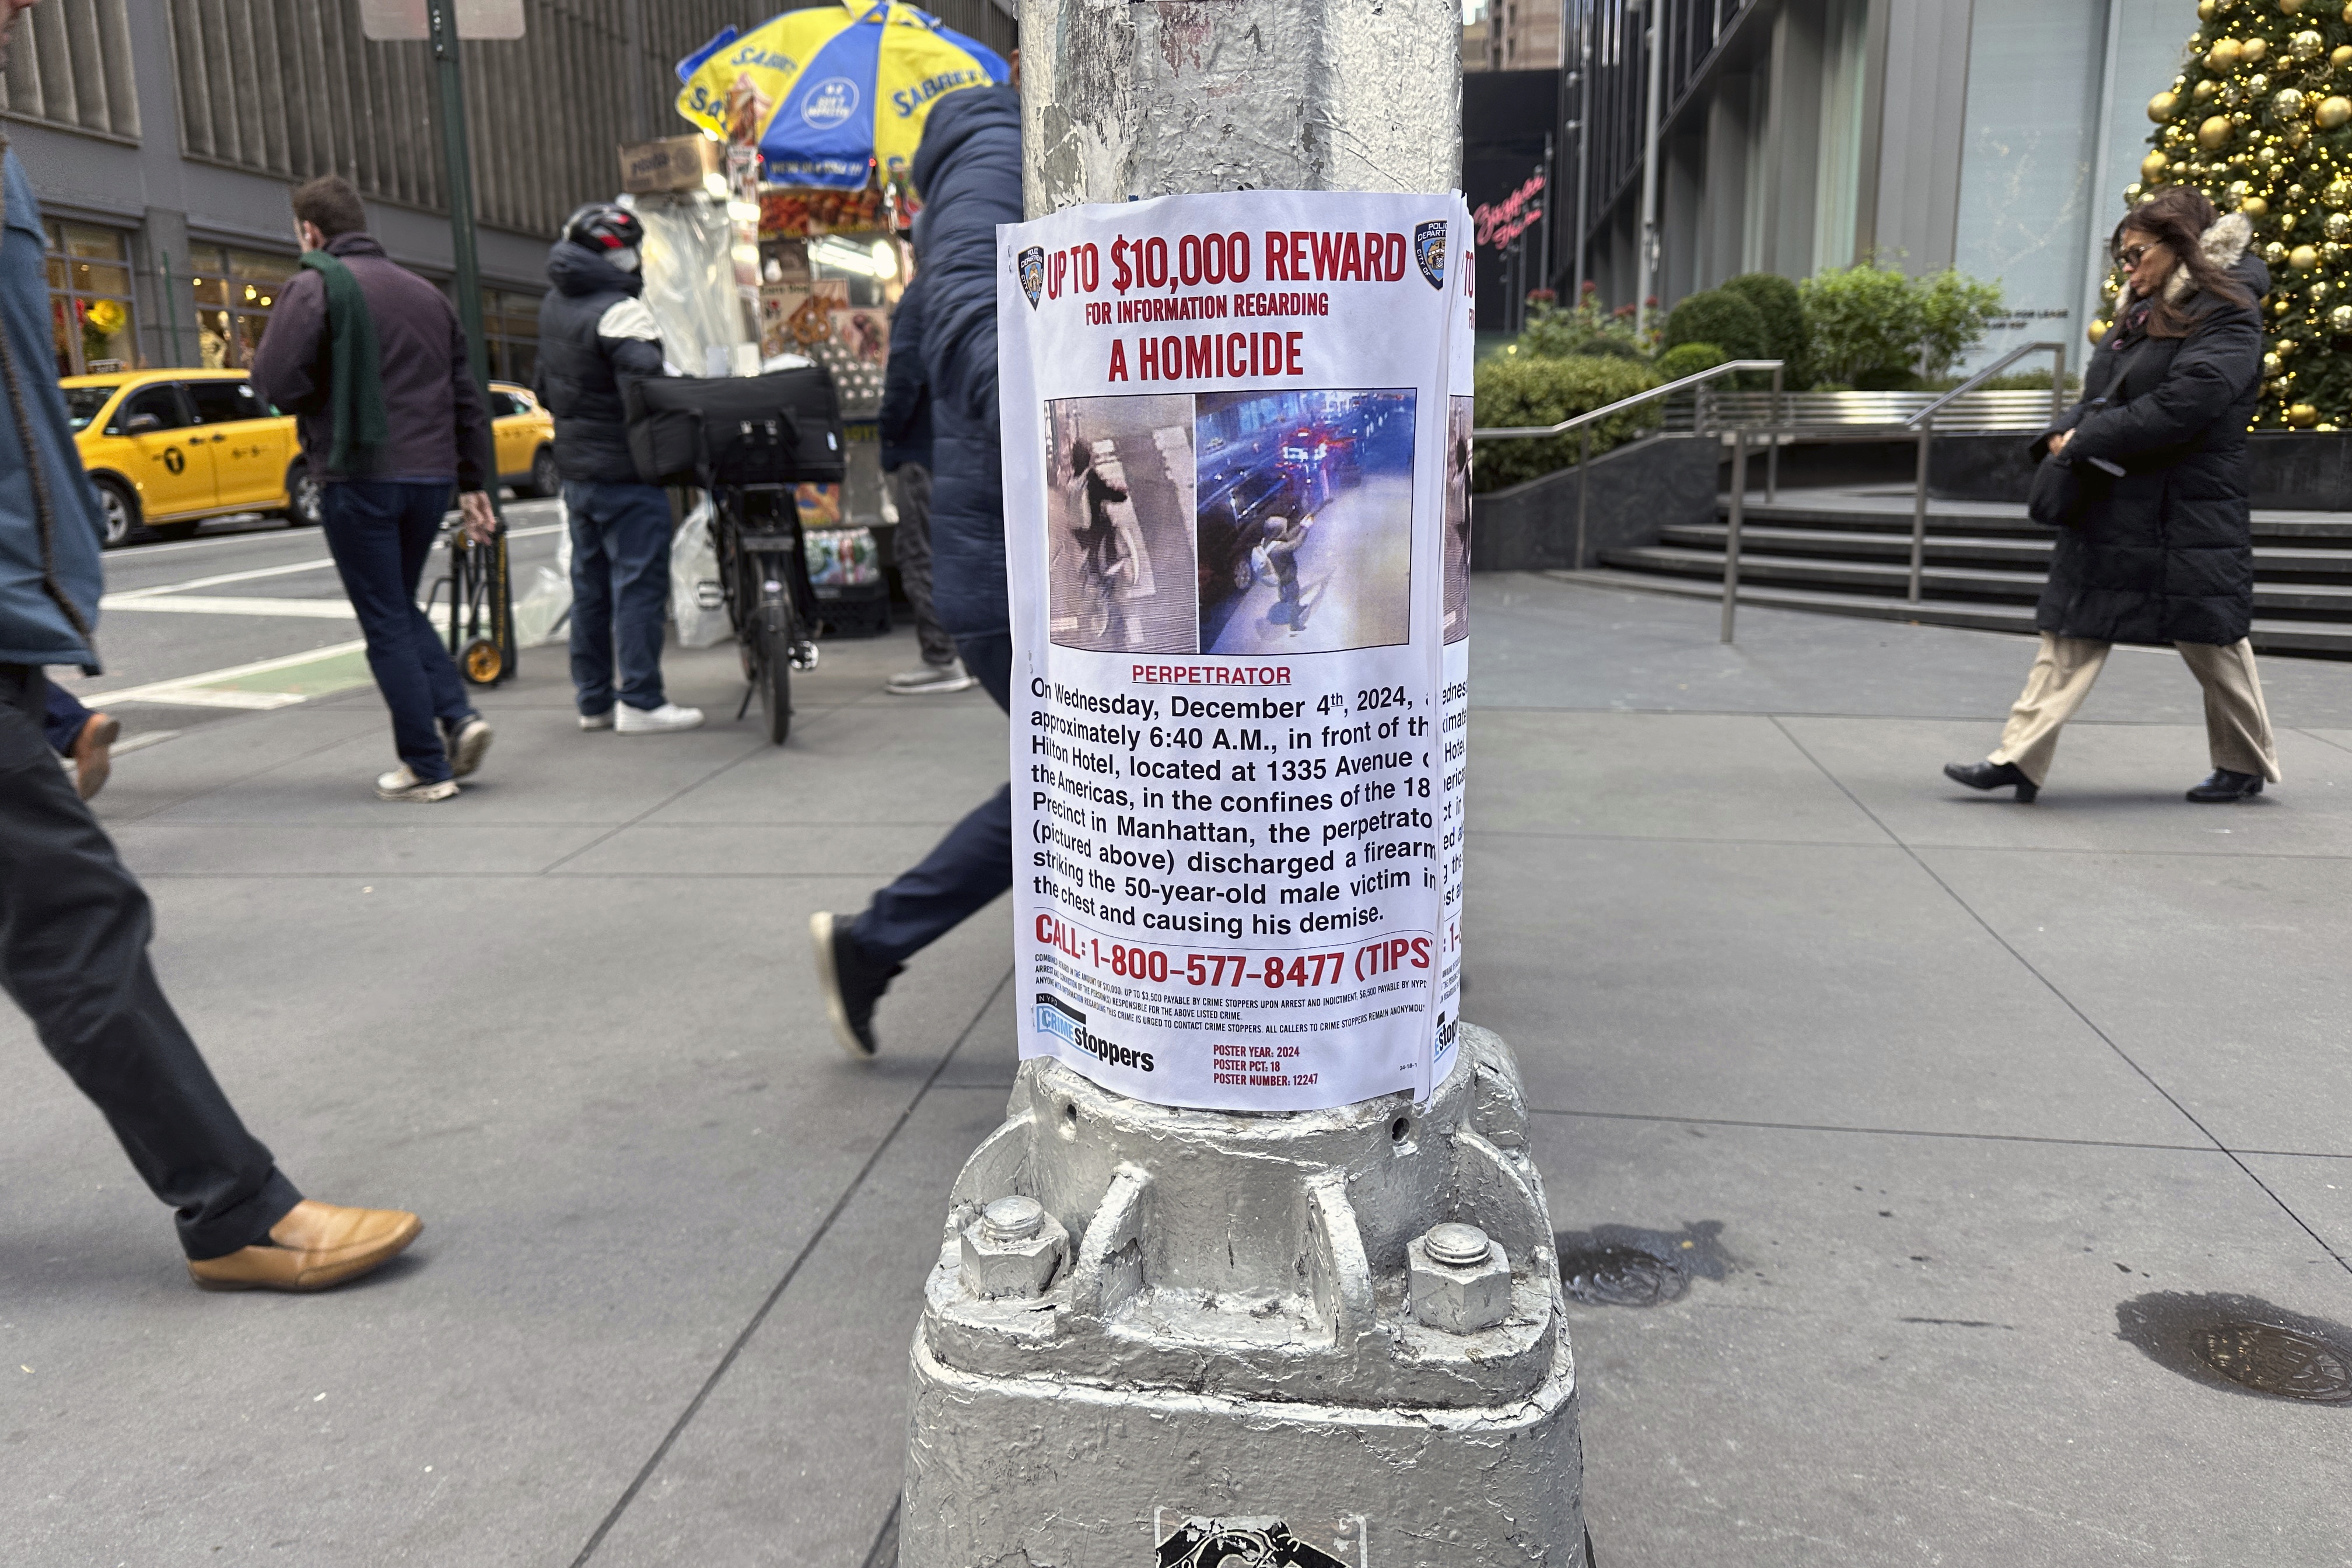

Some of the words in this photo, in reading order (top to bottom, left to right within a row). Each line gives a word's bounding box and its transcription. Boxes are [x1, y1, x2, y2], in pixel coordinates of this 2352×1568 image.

[1048, 250, 1066, 300] UP
[1070, 243, 1099, 293] TO
[1111, 232, 1250, 295] $10,000
[1265, 231, 1407, 282] REWARD
[1416, 249, 1425, 265] CITY
[1423, 267, 1431, 276] OF
[1086, 301, 1112, 326] FOR
[1117, 295, 1227, 324] INFORMATION
[1234, 292, 1328, 317] REGARDING
[1108, 339, 1129, 382] A
[1139, 331, 1304, 381] HOMICIDE
[1132, 664, 1291, 684] PERPETRATOR
[1031, 677, 1051, 700] On
[1055, 682, 1159, 721] Wednesday,
[1171, 695, 1306, 719] December
[1317, 692, 1348, 718] 4th,
[1357, 685, 1413, 711] 2024,
[1031, 710, 1140, 751] approximately
[1150, 726, 1203, 749] 6:40
[1212, 728, 1277, 754] A.M.,
[1289, 728, 1311, 750] in
[1321, 721, 1371, 747] front
[1378, 716, 1399, 738] of
[1032, 735, 1068, 764] Hilton
[1072, 747, 1120, 779] Hotel,
[1130, 755, 1220, 780] located
[1231, 762, 1256, 782] at
[1267, 758, 1326, 781] 1335
[1335, 751, 1413, 777] Avenue
[1031, 764, 1055, 786] the
[1058, 771, 1135, 811] Americas,
[1143, 787, 1164, 808] in
[1171, 789, 1212, 811] the
[1220, 790, 1333, 813] confines
[1340, 783, 1360, 807] of
[1365, 780, 1395, 803] the
[1032, 792, 1086, 827] Precinct
[1091, 810, 1107, 833] in
[1117, 815, 1255, 848] Manhattan,
[1268, 822, 1310, 844] the
[1032, 819, 1091, 858] (pictured
[1099, 844, 1174, 875] above)
[1187, 850, 1334, 879] discharged
[1345, 850, 1356, 868] a
[1364, 841, 1436, 863] firearm
[1033, 849, 1083, 887] striking
[1088, 868, 1115, 892] the
[1125, 876, 1266, 905] 50-year-old
[1280, 881, 1340, 904] male
[1349, 869, 1410, 897] victim
[1424, 867, 1436, 891] in
[1033, 876, 1059, 898] the
[1061, 887, 1096, 916] chest
[1100, 904, 1135, 926] and
[1143, 912, 1242, 939] causing
[1253, 914, 1292, 935] his
[1300, 906, 1384, 933] demise.
[1035, 914, 1086, 960] CALL:
[1091, 938, 1345, 989] 1-800-577-8477
[1354, 937, 1433, 982] (TIPS
[1035, 965, 1053, 974] ARREST
[1077, 982, 1082, 991] OF
[1112, 997, 1147, 1012] RESPONSIBLE
[1149, 1005, 1160, 1014] FOR
[1161, 1006, 1172, 1016] THE
[1174, 1008, 1195, 1017] ABOVE
[1197, 1010, 1217, 1019] LISTED
[1035, 976, 1054, 986] ANYONE
[1107, 1007, 1116, 1017] THIS
[1118, 1011, 1134, 1022] CRIME
[1136, 1015, 1141, 1023] IS
[1143, 1016, 1162, 1027] URGED
[1164, 1020, 1172, 1028] TO
[1174, 1020, 1203, 1030] CONTACT
[1205, 1023, 1226, 1031] CRIME
[1265, 1025, 1278, 1033] ALL
[1279, 1024, 1308, 1033] CALLERS
[1309, 1023, 1318, 1031] TO
[1320, 1021, 1340, 1031] CRIME
[1341, 1014, 1367, 1028] STOPPERS
[1368, 1009, 1389, 1021] REMAIN
[1039, 995, 1058, 1006] NYPD
[1097, 980, 1102, 988] OF
[1125, 988, 1132, 996] UP
[1133, 989, 1140, 998] TO
[1142, 991, 1161, 1002] $3,500
[1164, 995, 1190, 1005] PAYABLE
[1192, 997, 1200, 1005] BY
[1202, 998, 1223, 1007] CRIME
[1225, 999, 1258, 1008] STOPPERS
[1261, 1000, 1279, 1008] UPON
[1280, 999, 1306, 1008] ARREST
[1307, 998, 1321, 1007] AND
[1359, 986, 1376, 1000] $6,500
[1378, 981, 1399, 993] PAYABLE
[1401, 980, 1409, 989] BY
[1213, 1044, 1246, 1057] POSTER
[1248, 1046, 1274, 1058] YEAR:
[1276, 1046, 1300, 1058] 2024
[1213, 1058, 1246, 1071] POSTER
[1249, 1061, 1268, 1072] PCT:
[1270, 1061, 1280, 1072] 18
[1213, 1073, 1247, 1086] POSTER
[1250, 1074, 1290, 1086] NUMBER:
[1293, 1073, 1318, 1086] 12247
